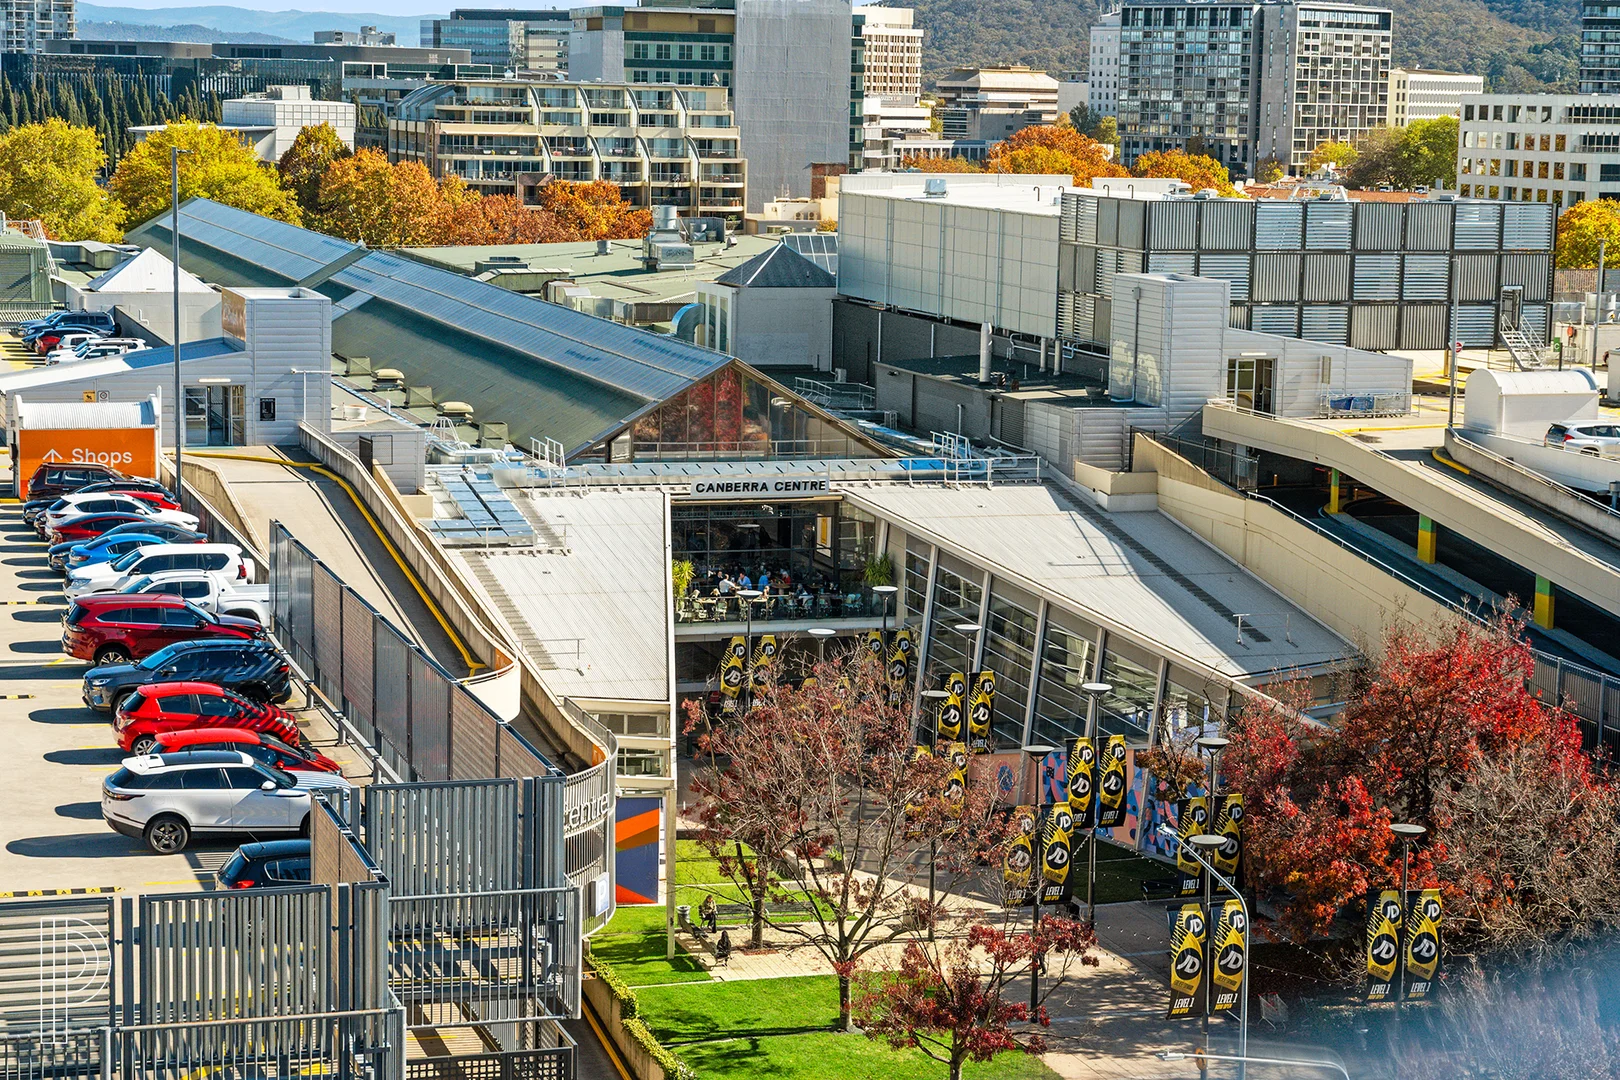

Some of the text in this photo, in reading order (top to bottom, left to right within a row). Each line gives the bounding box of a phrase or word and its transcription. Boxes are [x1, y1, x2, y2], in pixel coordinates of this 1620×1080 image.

[72, 448, 132, 468] Shops
[696, 480, 826, 493] CANBERRA CENTRE
[942, 708, 960, 723] JD
[973, 706, 988, 720] JD
[1082, 749, 1092, 760] JD
[1114, 746, 1124, 758] JD
[1072, 778, 1090, 793] JD
[1104, 776, 1122, 790] JD
[564, 792, 610, 830] entre
[1060, 816, 1072, 828] JD
[1047, 847, 1068, 864] JD
[1046, 886, 1061, 896] LEVEL
[1387, 905, 1400, 918] JD
[1428, 904, 1440, 918] JD
[1190, 918, 1202, 932] JD
[1234, 914, 1244, 928] JD
[1373, 940, 1396, 960] JD
[1413, 938, 1436, 958] JD
[1176, 954, 1200, 974] JD
[1220, 950, 1243, 970] JD
[1370, 984, 1386, 994] LEVEL
[1411, 982, 1426, 992] LEVEL
[1174, 998, 1190, 1008] LEVEL
[1216, 994, 1234, 1004] LEVEL
